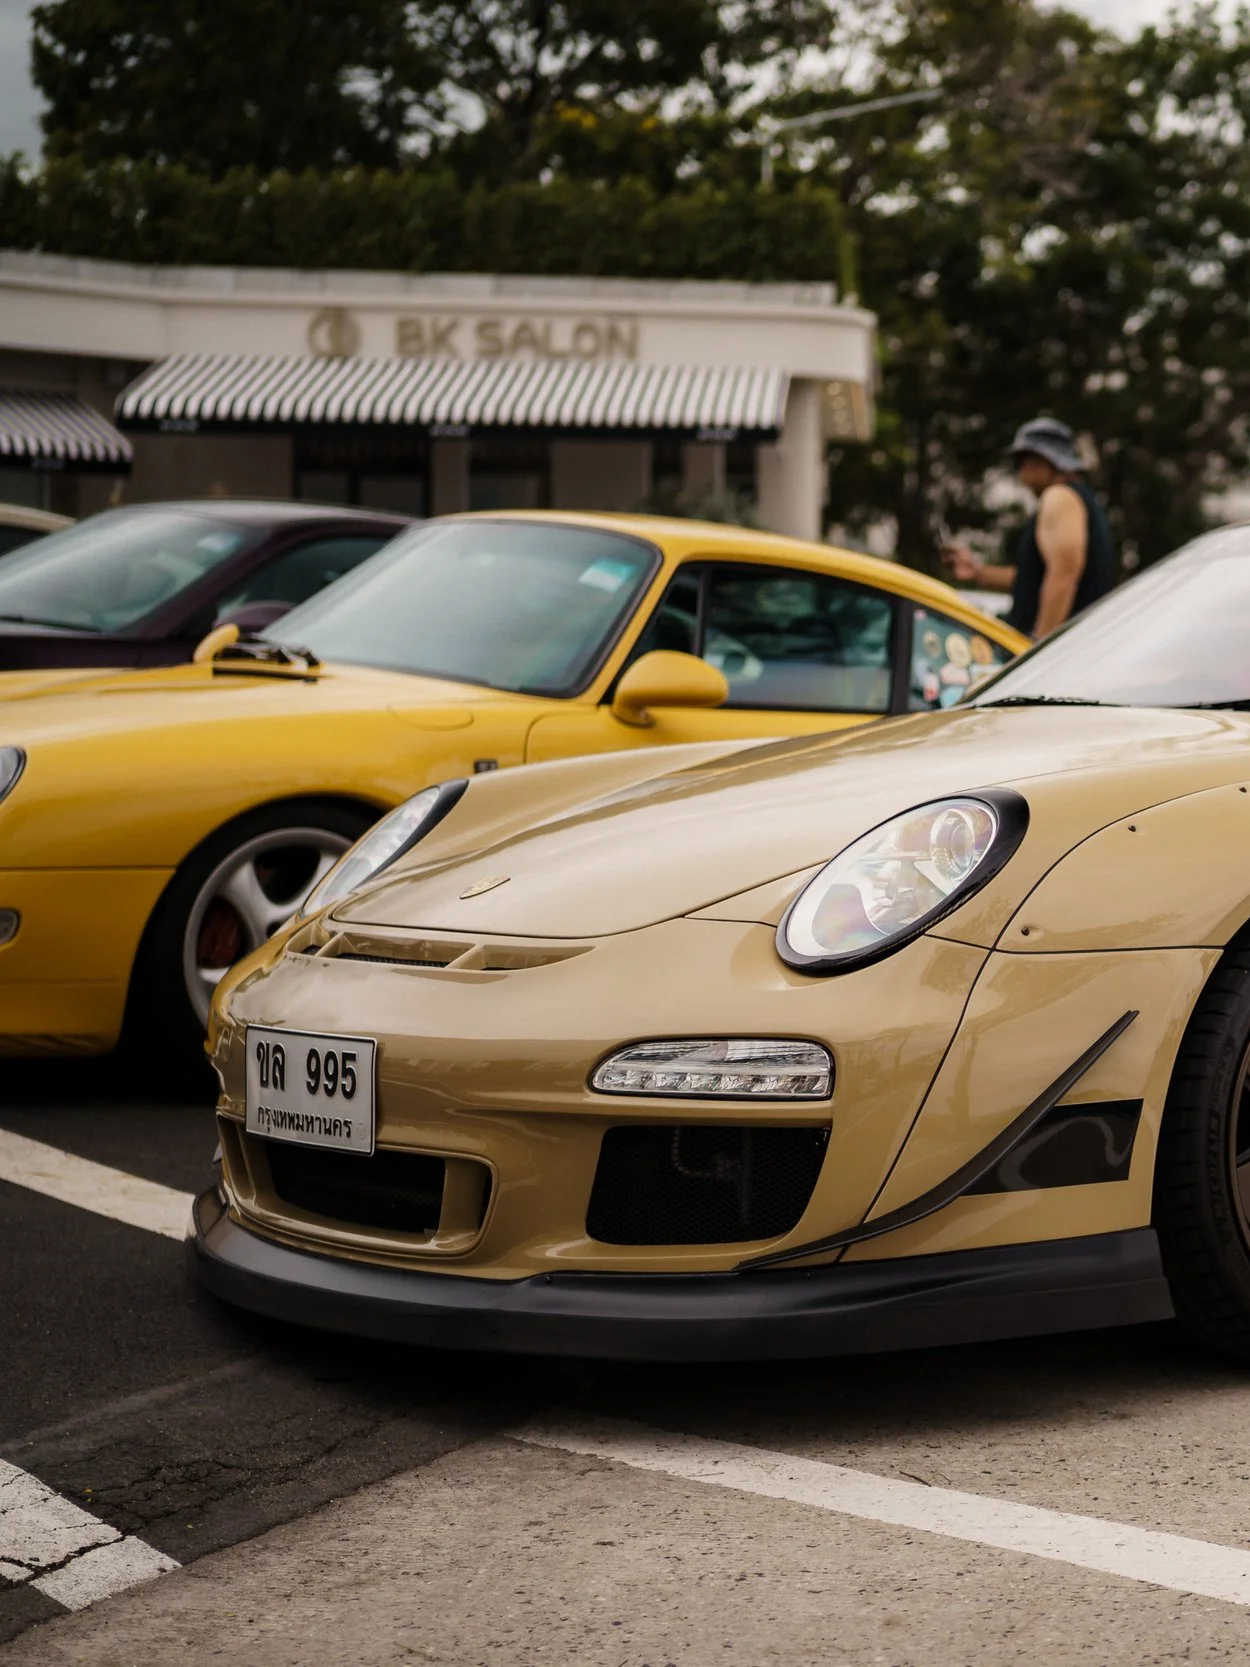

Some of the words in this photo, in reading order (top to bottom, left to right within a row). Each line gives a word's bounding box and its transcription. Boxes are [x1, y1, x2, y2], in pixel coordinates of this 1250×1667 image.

[395, 317, 459, 357] BK
[474, 318, 638, 361] SALON
[257, 1041, 286, 1090] ขล
[306, 1048, 357, 1099] 995
[257, 1105, 353, 1138] กรุงเทพมหานคร
